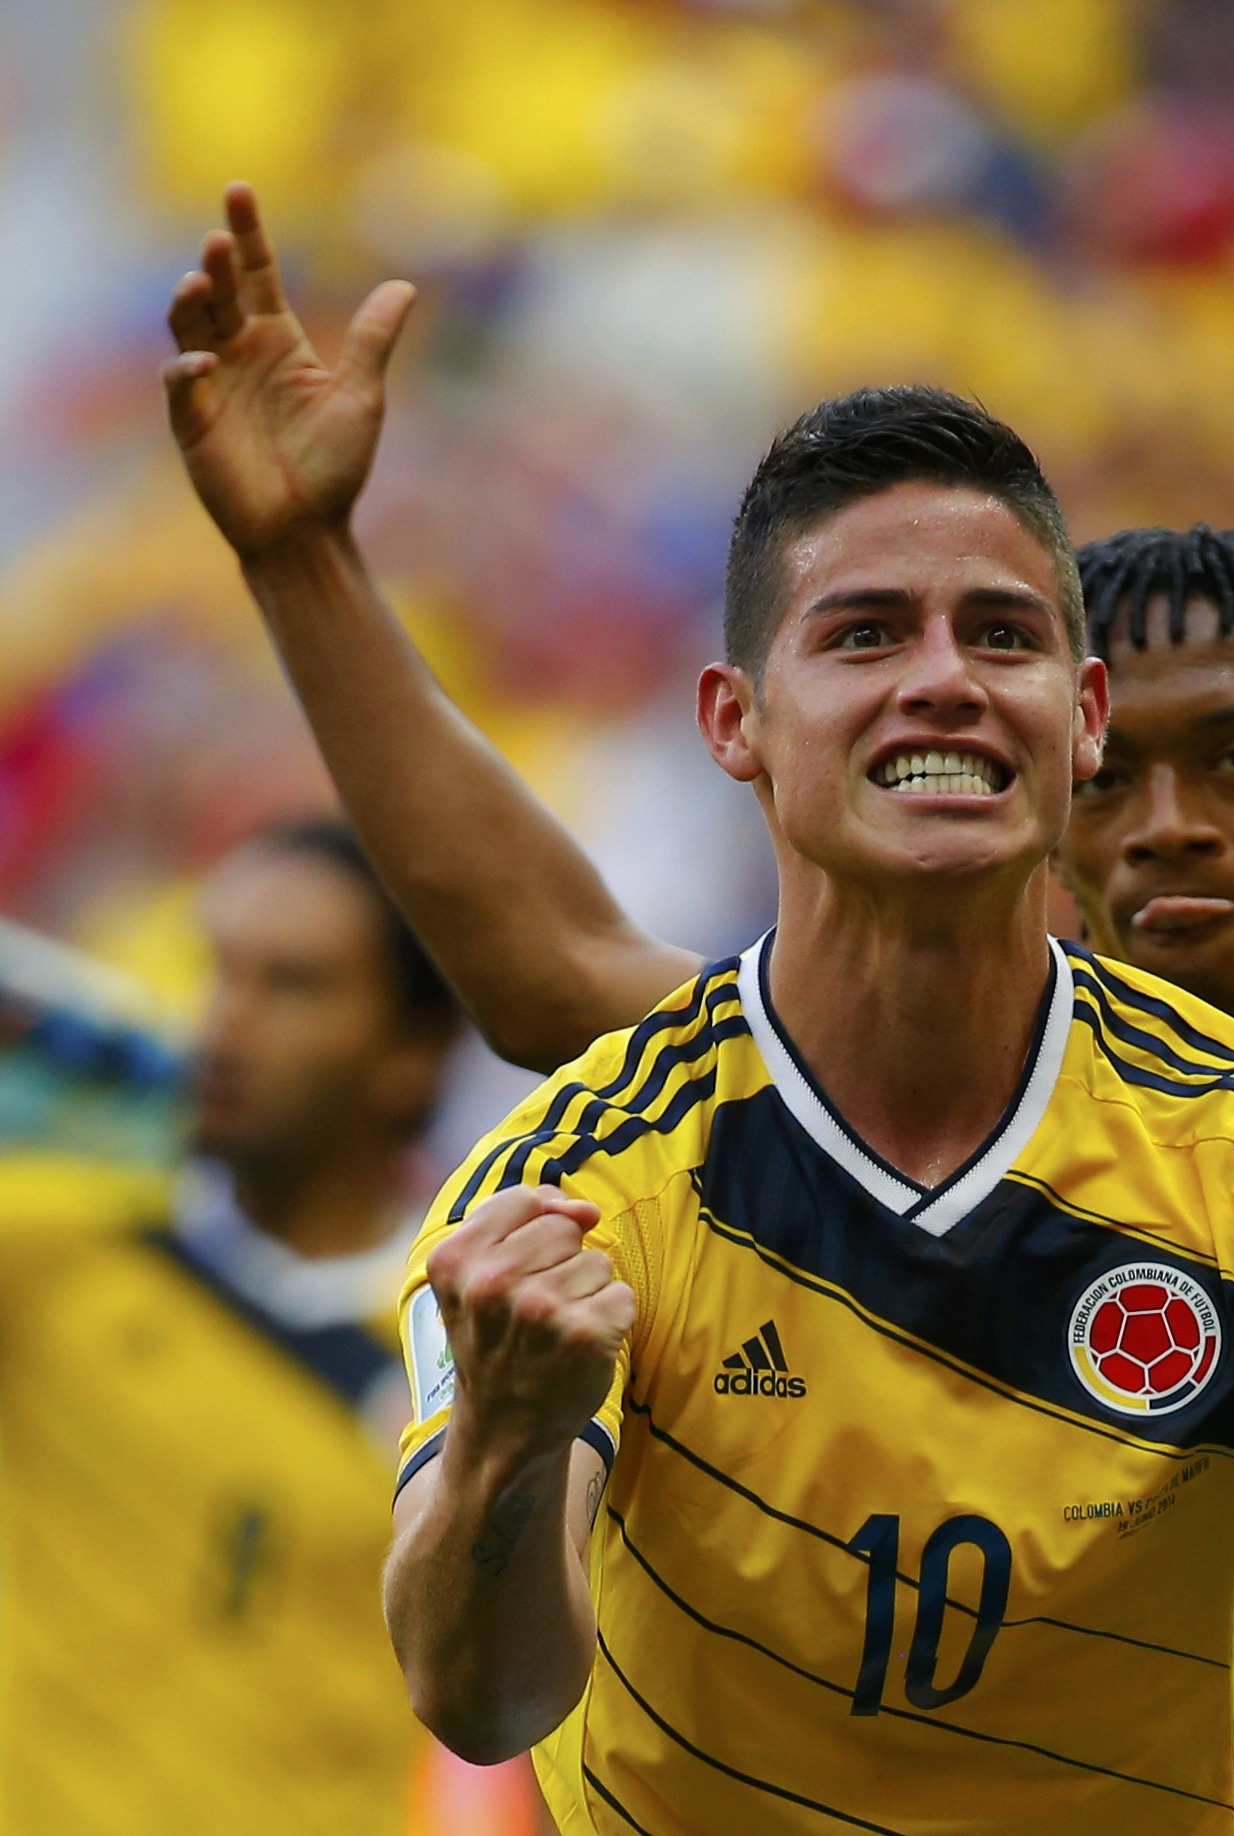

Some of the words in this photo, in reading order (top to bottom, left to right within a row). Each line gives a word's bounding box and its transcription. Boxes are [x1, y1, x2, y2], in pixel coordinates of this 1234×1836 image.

[1073, 1284, 1109, 1344] FEDERACION
[1108, 1268, 1178, 1288] COLOMBIANA
[1179, 1280, 1194, 1297] DE
[1190, 1294, 1216, 1334] FUTBOL
[427, 1384, 440, 1402] FIFA
[713, 1367, 808, 1399] adidas
[1063, 1502, 1124, 1521] COLOMBIA
[1128, 1500, 1143, 1515] VS
[846, 1513, 1012, 1717] 10
